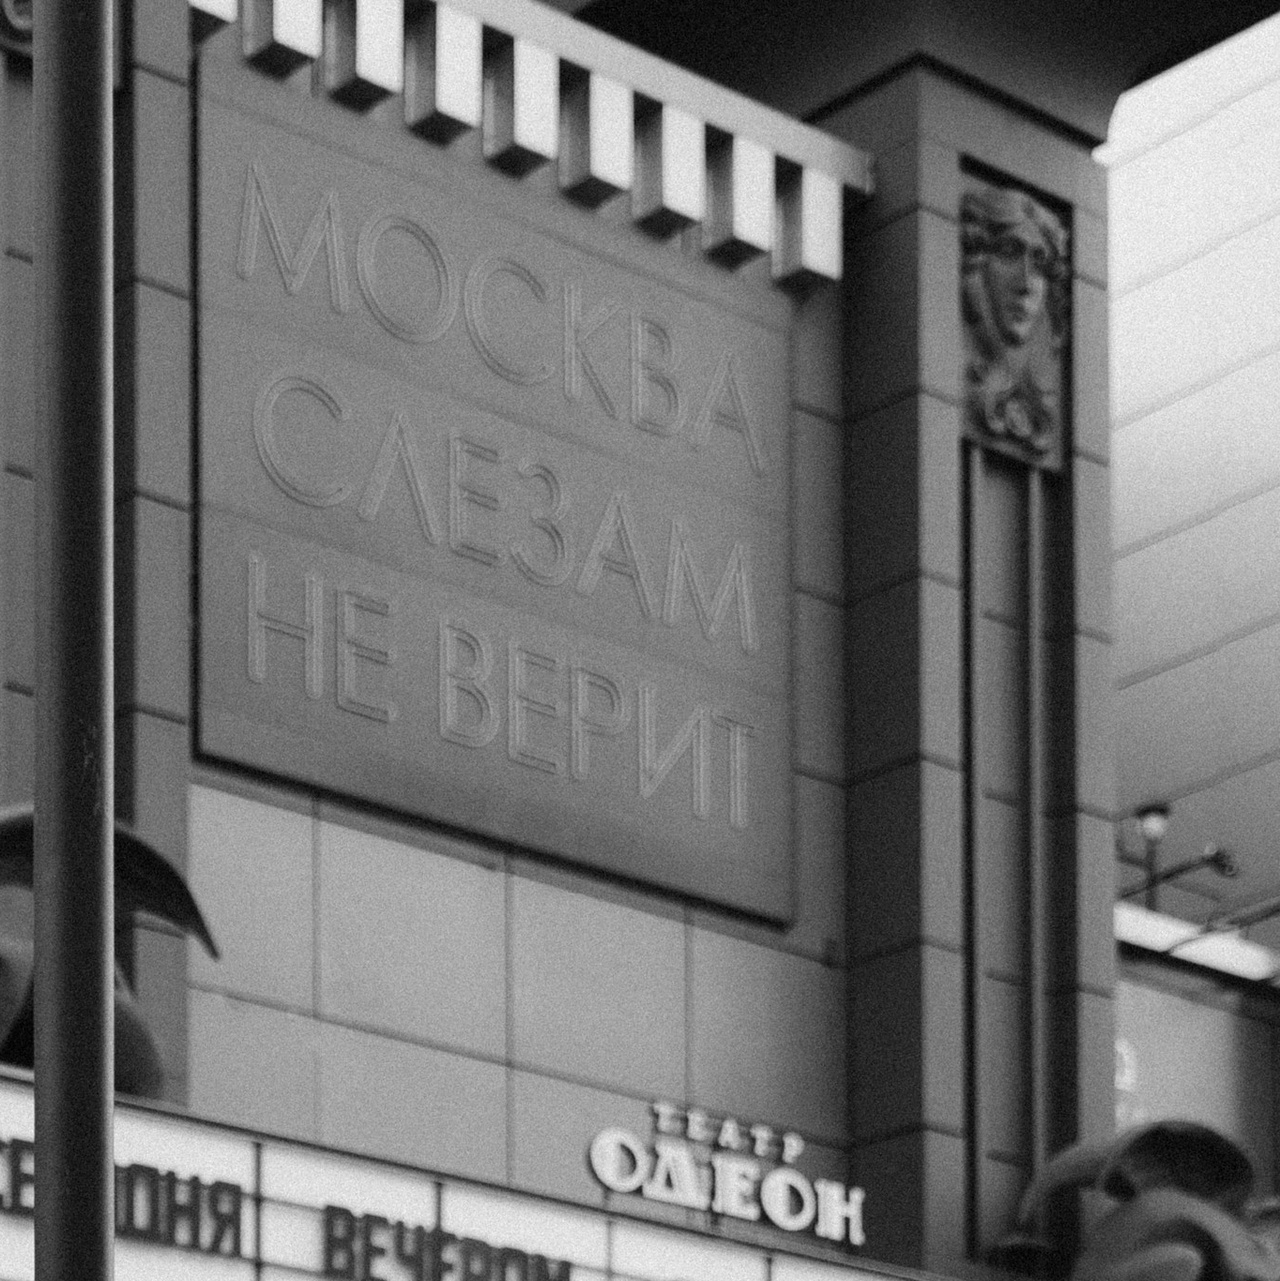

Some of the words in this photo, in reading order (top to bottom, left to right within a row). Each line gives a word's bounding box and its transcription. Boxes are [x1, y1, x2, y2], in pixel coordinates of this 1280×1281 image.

[236, 161, 770, 477] МОСКВА
[251, 373, 760, 656] СЛЕЗАМ
[246, 550, 398, 727] НЕ
[439, 612, 758, 831] ВЕРИТ
[587, 1126, 866, 1246] ОДЕОН
